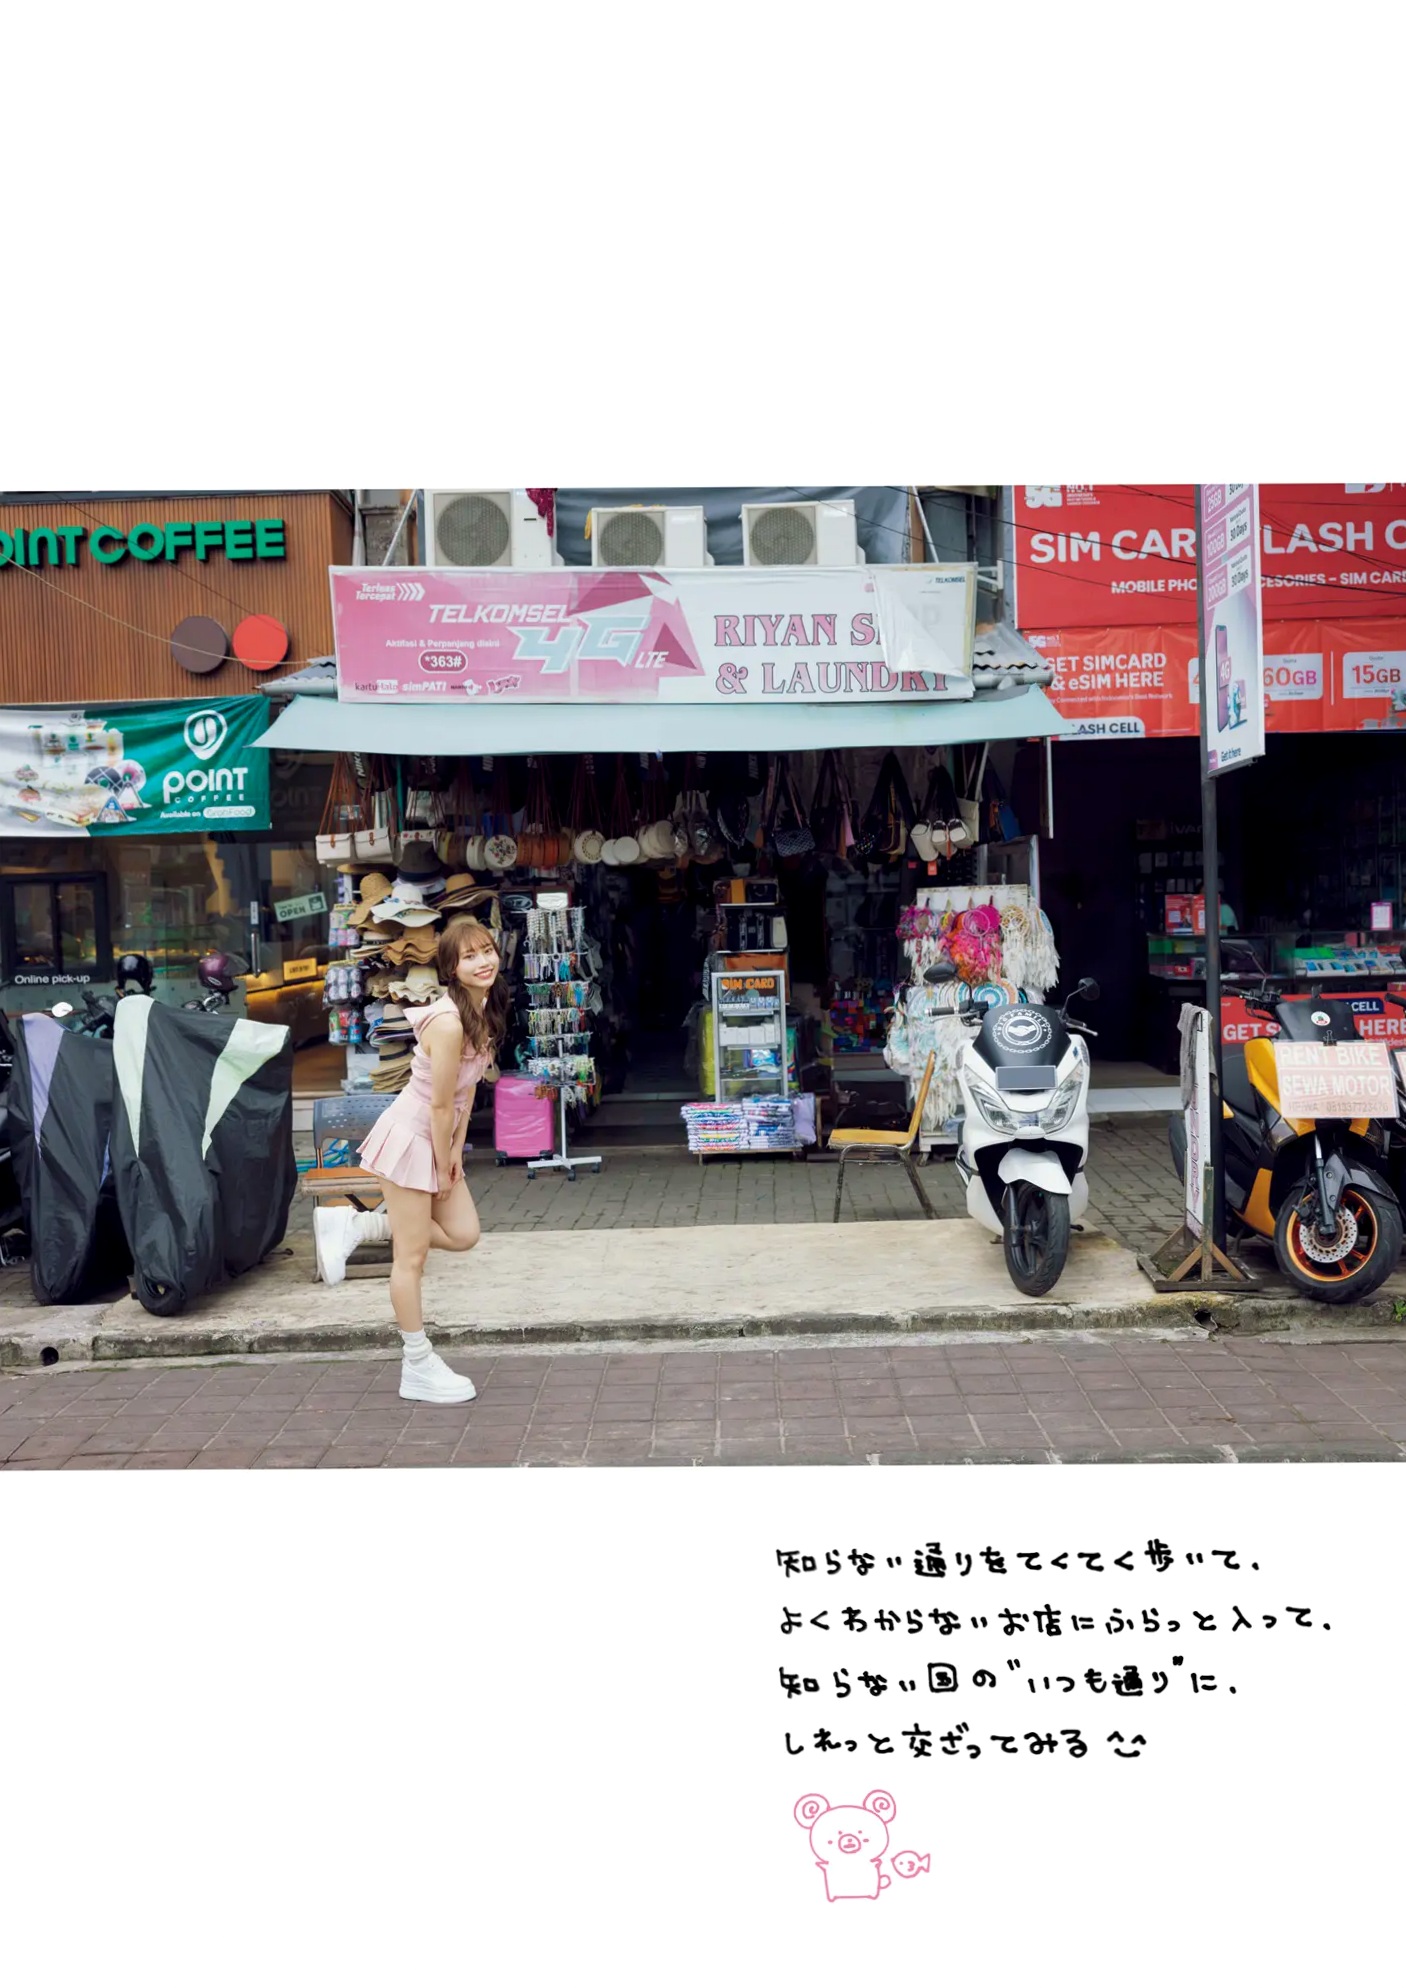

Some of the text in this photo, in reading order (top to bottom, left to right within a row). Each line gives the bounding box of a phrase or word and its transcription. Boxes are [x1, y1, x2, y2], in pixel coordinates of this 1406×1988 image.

[89, 518, 286, 565] COFFEE
[1030, 531, 1101, 563] SIM
[1111, 527, 1197, 561] CAR
[1263, 521, 1374, 554] LASH
[1111, 580, 1166, 594] MOBILE
[1168, 578, 1197, 591] PHO
[1261, 574, 1326, 588] CESORIES
[1340, 572, 1367, 585] SIM
[428, 604, 573, 624] TELKOMSEL
[714, 614, 838, 647] RIYAN
[507, 614, 651, 674] 4G
[634, 650, 669, 669] LTE
[1083, 653, 1167, 671] SIMCARD
[715, 662, 749, 694] &
[1068, 674, 1111, 690] eSIM
[1115, 671, 1165, 688] HERE
[1352, 664, 1401, 684] 15GB
[1078, 722, 1141, 735] ASH CELL
[174, 794, 245, 804] COFFEE
[279, 905, 306, 919] OPEN
[14, 973, 91, 986] Online pick-up
[745, 977, 775, 990] CARD
[1351, 1001, 1380, 1012] CELL
[1223, 1023, 1263, 1041] GET
[1280, 1046, 1382, 1068] RENT BIKE
[1282, 1074, 1392, 1097] SEWA MOTOR
